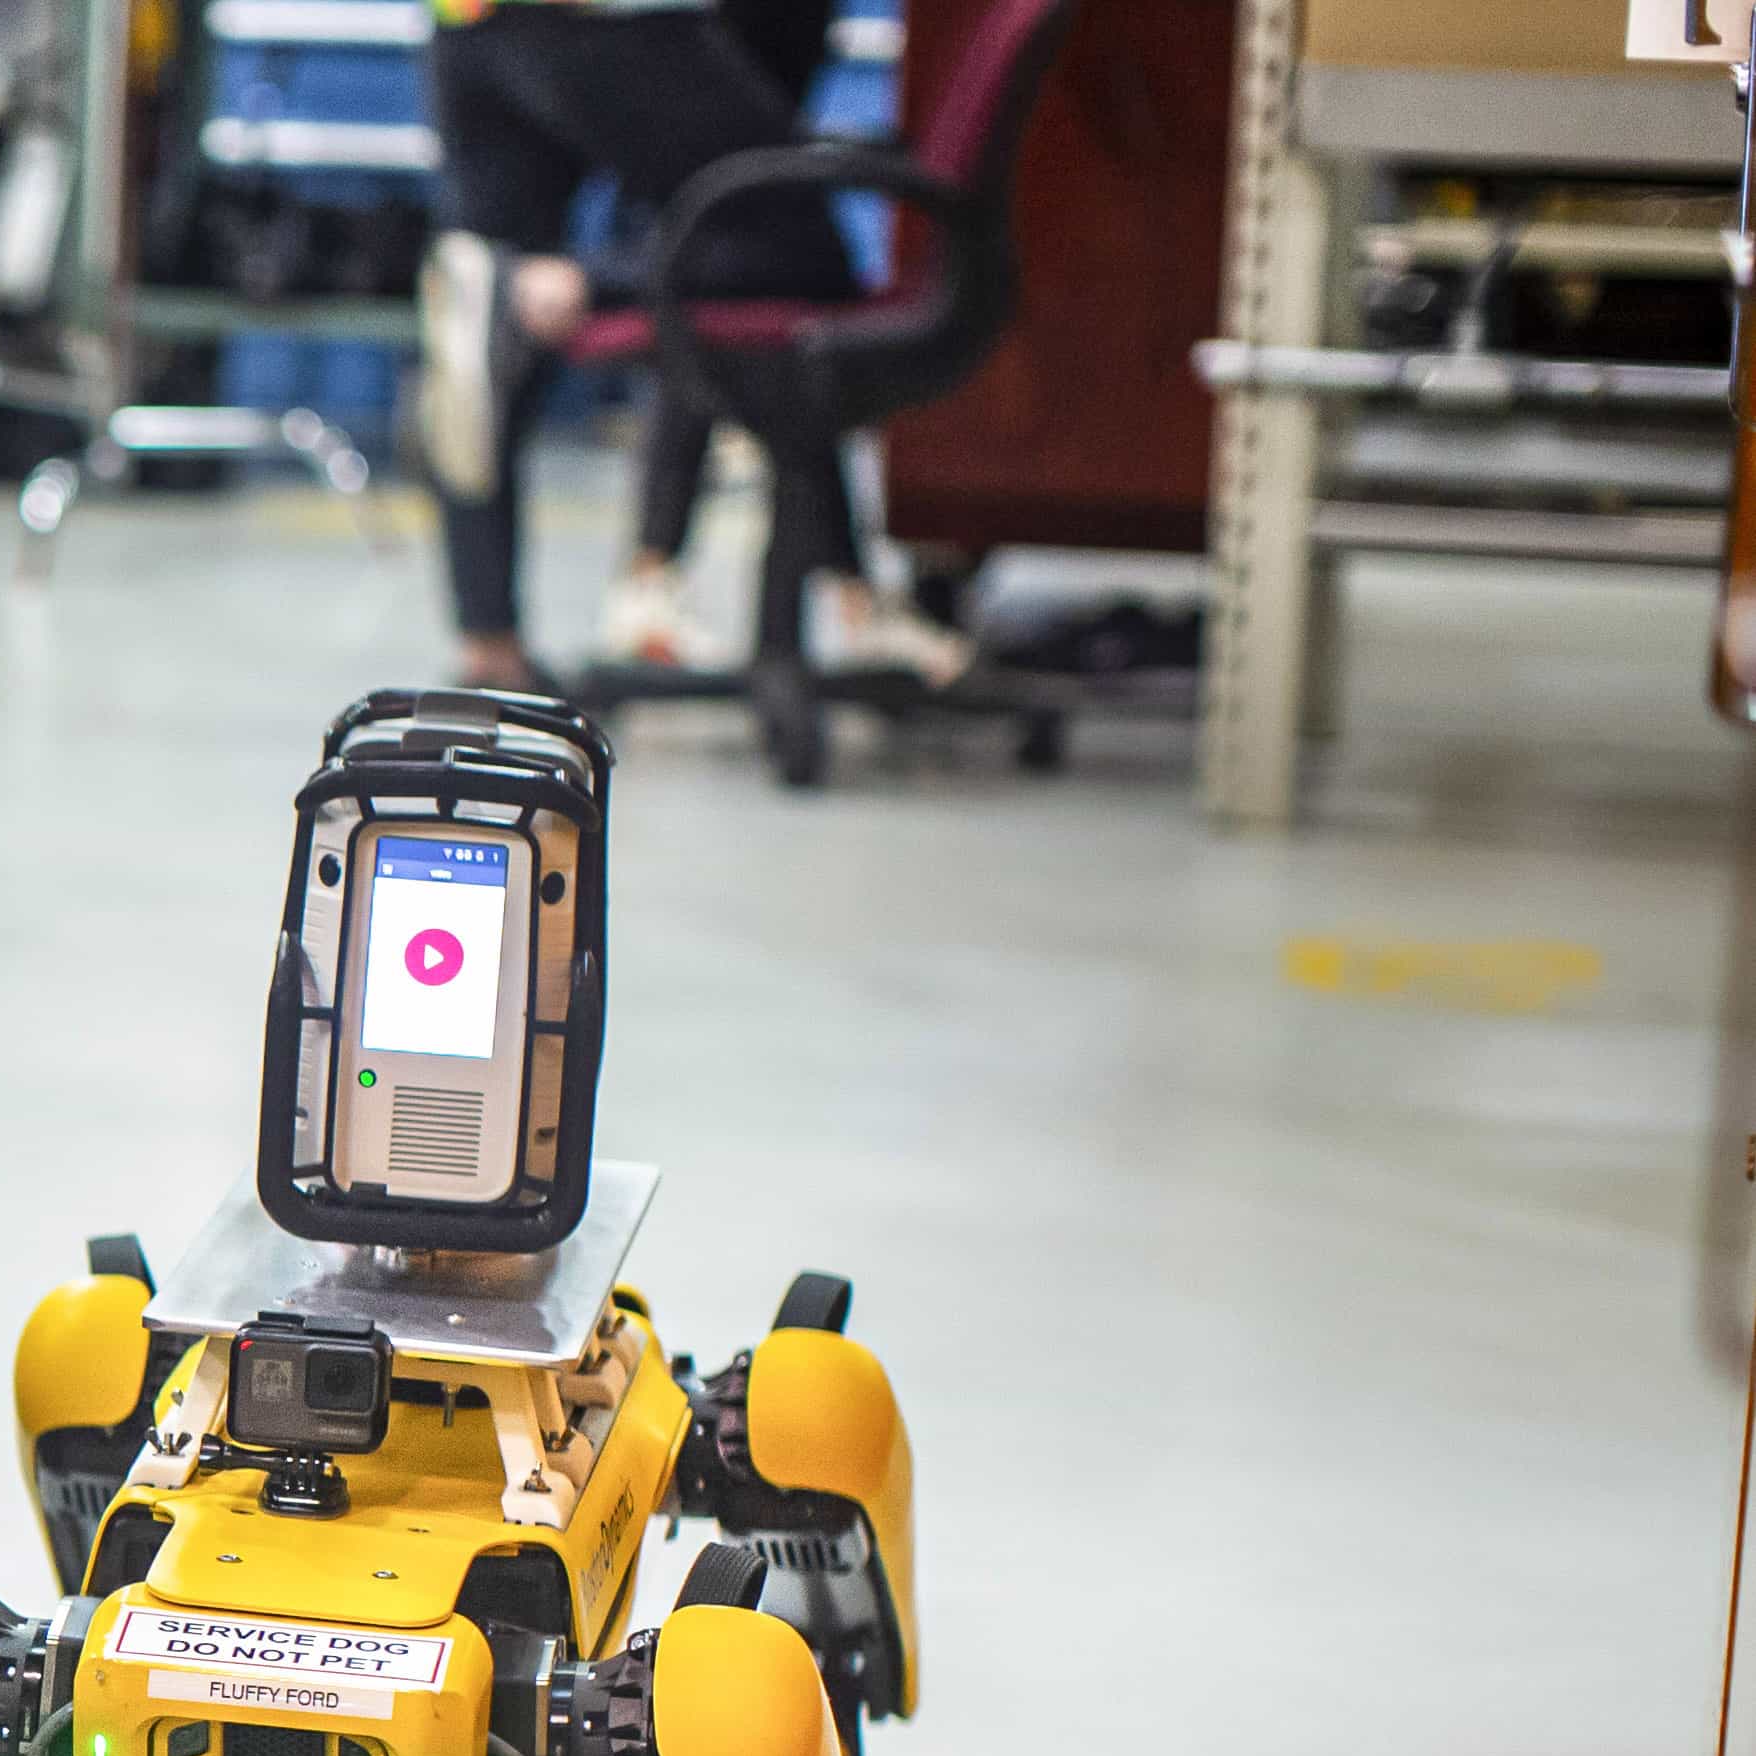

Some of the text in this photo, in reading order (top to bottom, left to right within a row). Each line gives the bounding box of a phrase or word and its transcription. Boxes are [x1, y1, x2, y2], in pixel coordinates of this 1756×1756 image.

[157, 1620, 409, 1656] SERVICE DOG
[166, 1640, 392, 1672] DO NOT PET
[209, 1681, 340, 1709] FLUFFY FORD
